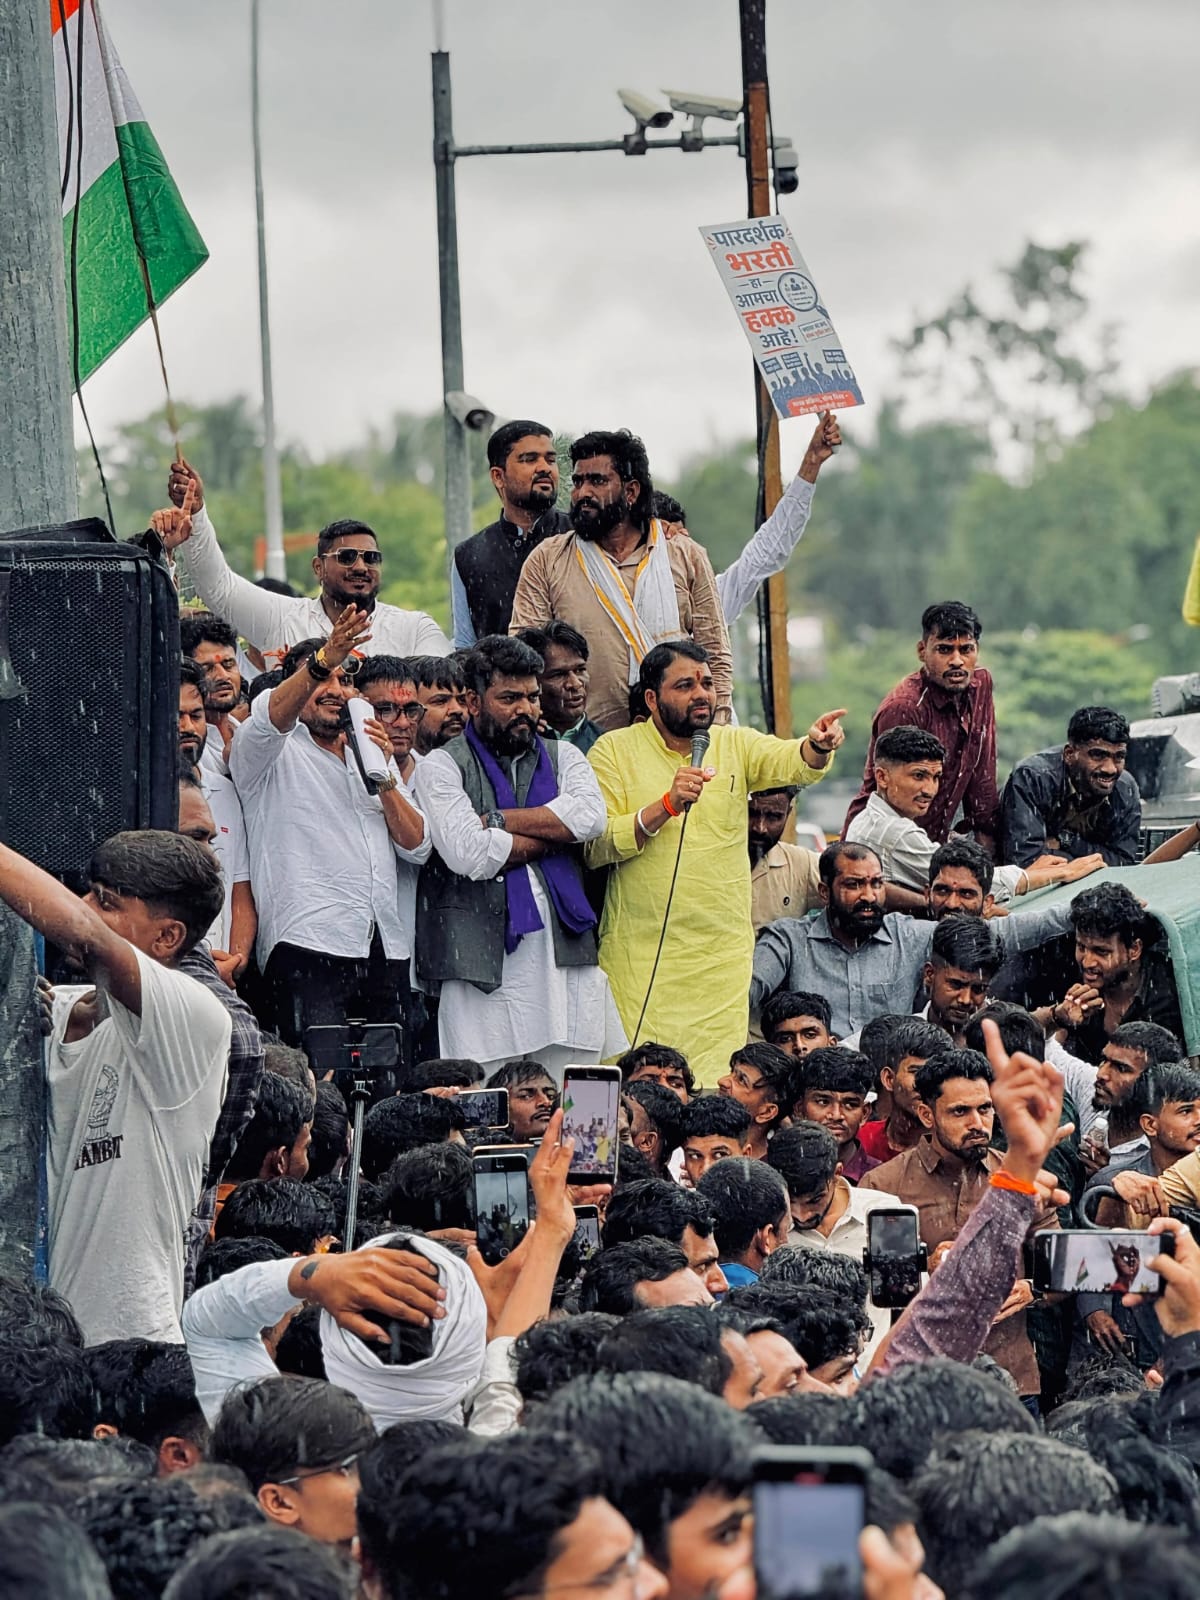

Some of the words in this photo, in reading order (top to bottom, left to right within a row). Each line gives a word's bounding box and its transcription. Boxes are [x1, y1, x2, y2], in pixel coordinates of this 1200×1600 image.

[712, 221, 785, 247] पारदर्शक
[725, 241, 794, 272] भरती
[748, 278, 762, 289] हा
[736, 289, 779, 308] आमचा
[742, 305, 796, 333] हक्क
[760, 327, 799, 348] आहे!
